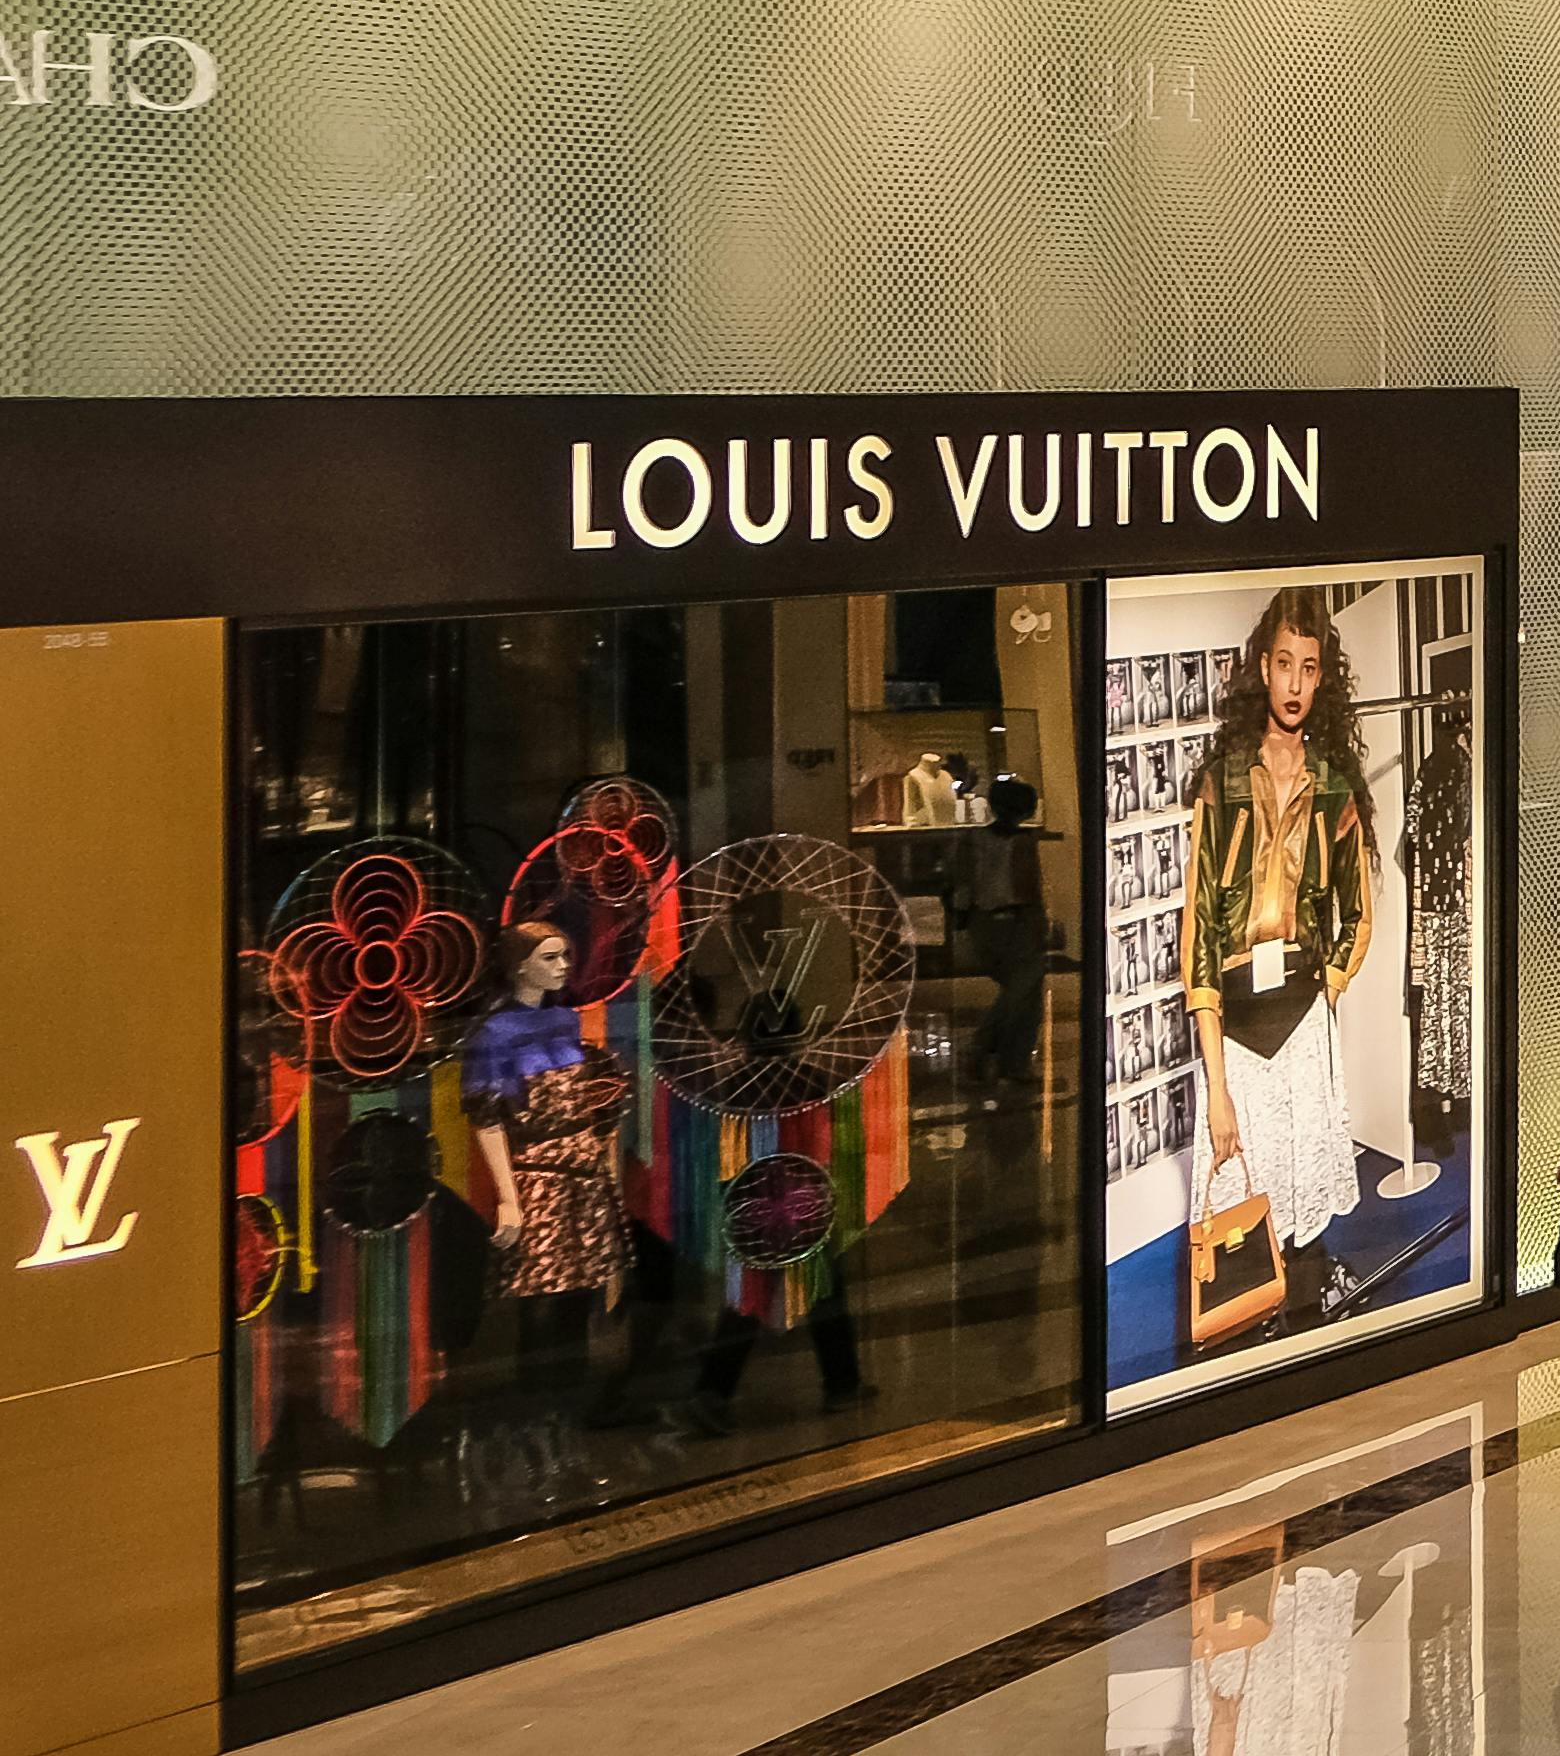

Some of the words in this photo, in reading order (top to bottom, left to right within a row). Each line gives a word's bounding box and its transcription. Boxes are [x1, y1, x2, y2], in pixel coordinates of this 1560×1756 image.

[571, 433, 894, 550] LOUIS
[935, 424, 1319, 539] VUITTON
[15, 1117, 142, 1270] LV
